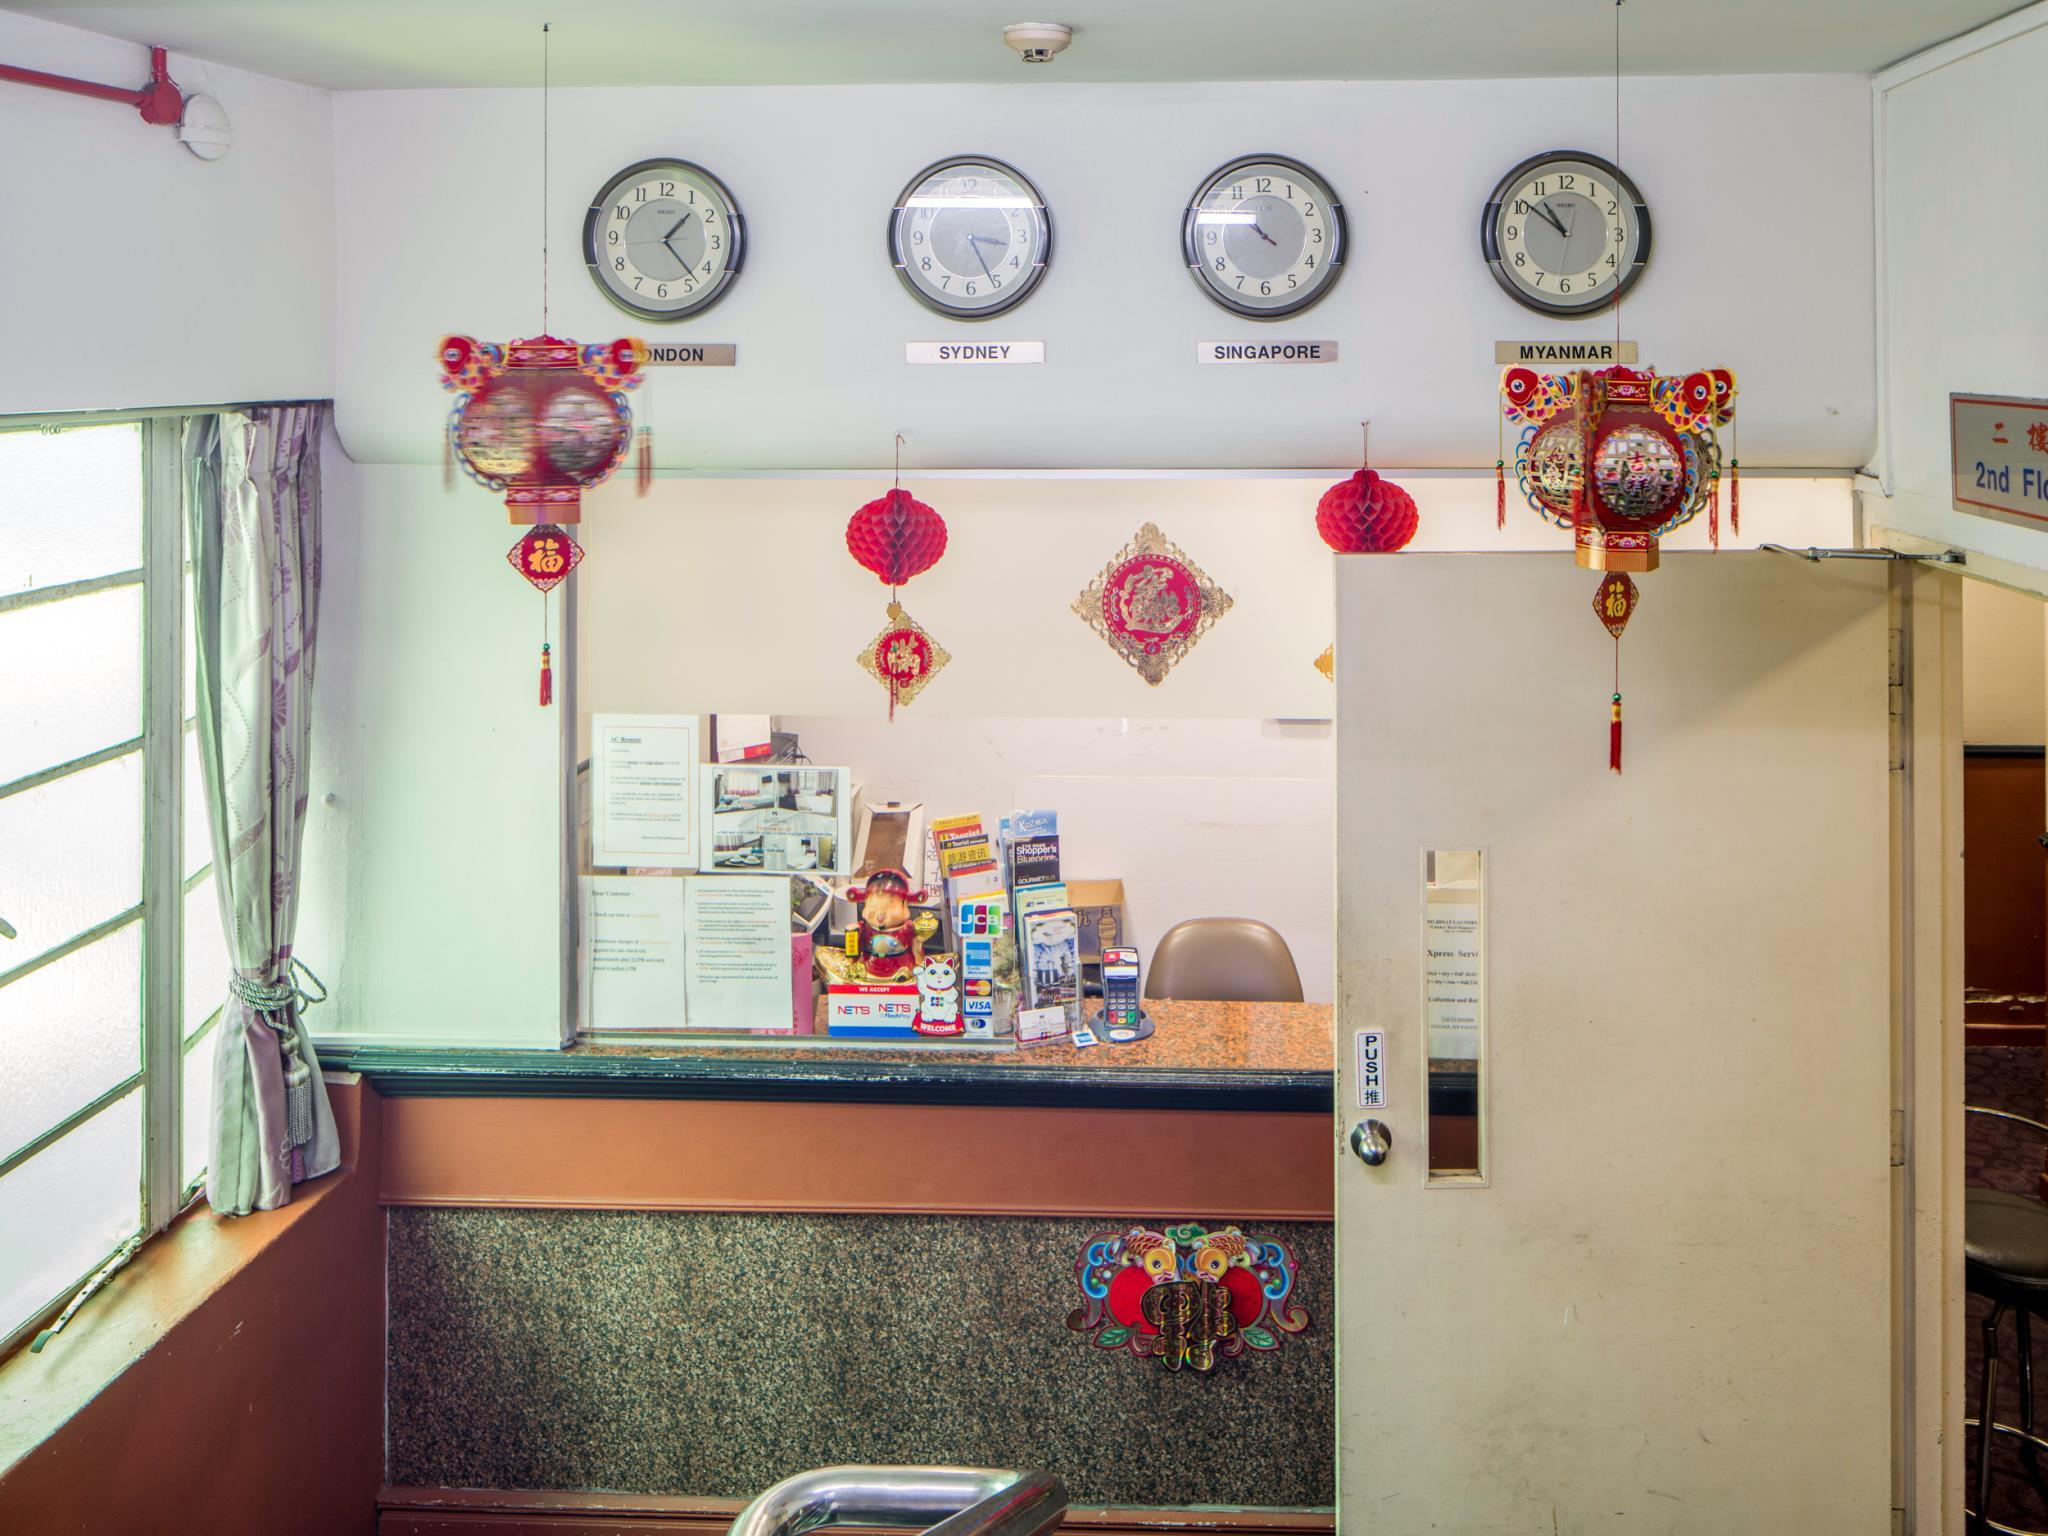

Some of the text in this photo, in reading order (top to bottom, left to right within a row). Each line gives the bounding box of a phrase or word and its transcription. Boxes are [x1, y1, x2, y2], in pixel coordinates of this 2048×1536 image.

[659, 183, 674, 196] 12
[1256, 178, 1271, 192] 12
[1534, 182, 1545, 195] 11
[1558, 176, 1575, 189] 12
[1590, 183, 1596, 196] 1
[635, 188, 646, 201] 11
[689, 191, 694, 204] 1
[1232, 186, 1243, 199] 11
[1287, 185, 1293, 198] 1
[616, 206, 630, 220] 10
[1305, 203, 1314, 216] 2
[1514, 201, 1528, 214] 10
[1608, 201, 1616, 215] 2
[706, 209, 714, 223] 2
[609, 231, 618, 245] 9
[914, 231, 923, 245] 9
[1017, 229, 1027, 243] 3
[1207, 231, 1217, 245] 9
[1312, 229, 1322, 243] 3
[1507, 226, 1517, 240] 9
[1614, 228, 1623, 242] 3
[711, 236, 720, 249] 3
[615, 257, 624, 271] 8
[922, 257, 931, 271] 8
[1010, 255, 1019, 268] 4
[1216, 257, 1225, 271] 8
[1305, 255, 1315, 268] 4
[1515, 252, 1525, 266] 8
[1606, 254, 1616, 267] 4
[702, 261, 712, 274] 4
[634, 277, 643, 290] 7
[685, 279, 693, 293] 5
[941, 276, 950, 289] 7
[993, 275, 1002, 288] 5
[1236, 276, 1245, 289] 7
[1288, 275, 1296, 288] 5
[1536, 273, 1544, 286] 7
[1560, 279, 1570, 293] 6
[1588, 273, 1596, 286] 5
[657, 284, 667, 298] 6
[966, 281, 976, 295] 6
[1261, 281, 1271, 295] 6
[644, 347, 704, 362] ONDON
[939, 345, 1010, 360] SYDNEY
[1214, 345, 1321, 360] SINGAPORE
[1520, 345, 1613, 360] MYANMAR
[1976, 461, 2010, 494] 2nd
[528, 538, 564, 573] 福
[1605, 580, 1627, 618] 福
[1016, 844, 1057, 857] Shopper's
[1427, 950, 1478, 958] Xpress Servi
[838, 1006, 871, 1015] NETS
[878, 1003, 911, 1013] NETS
[968, 1001, 992, 1010] VISA
[920, 1023, 956, 1032] WELCOME
[1365, 1036, 1378, 1086] PUSH
[1364, 1090, 1380, 1104] 推
